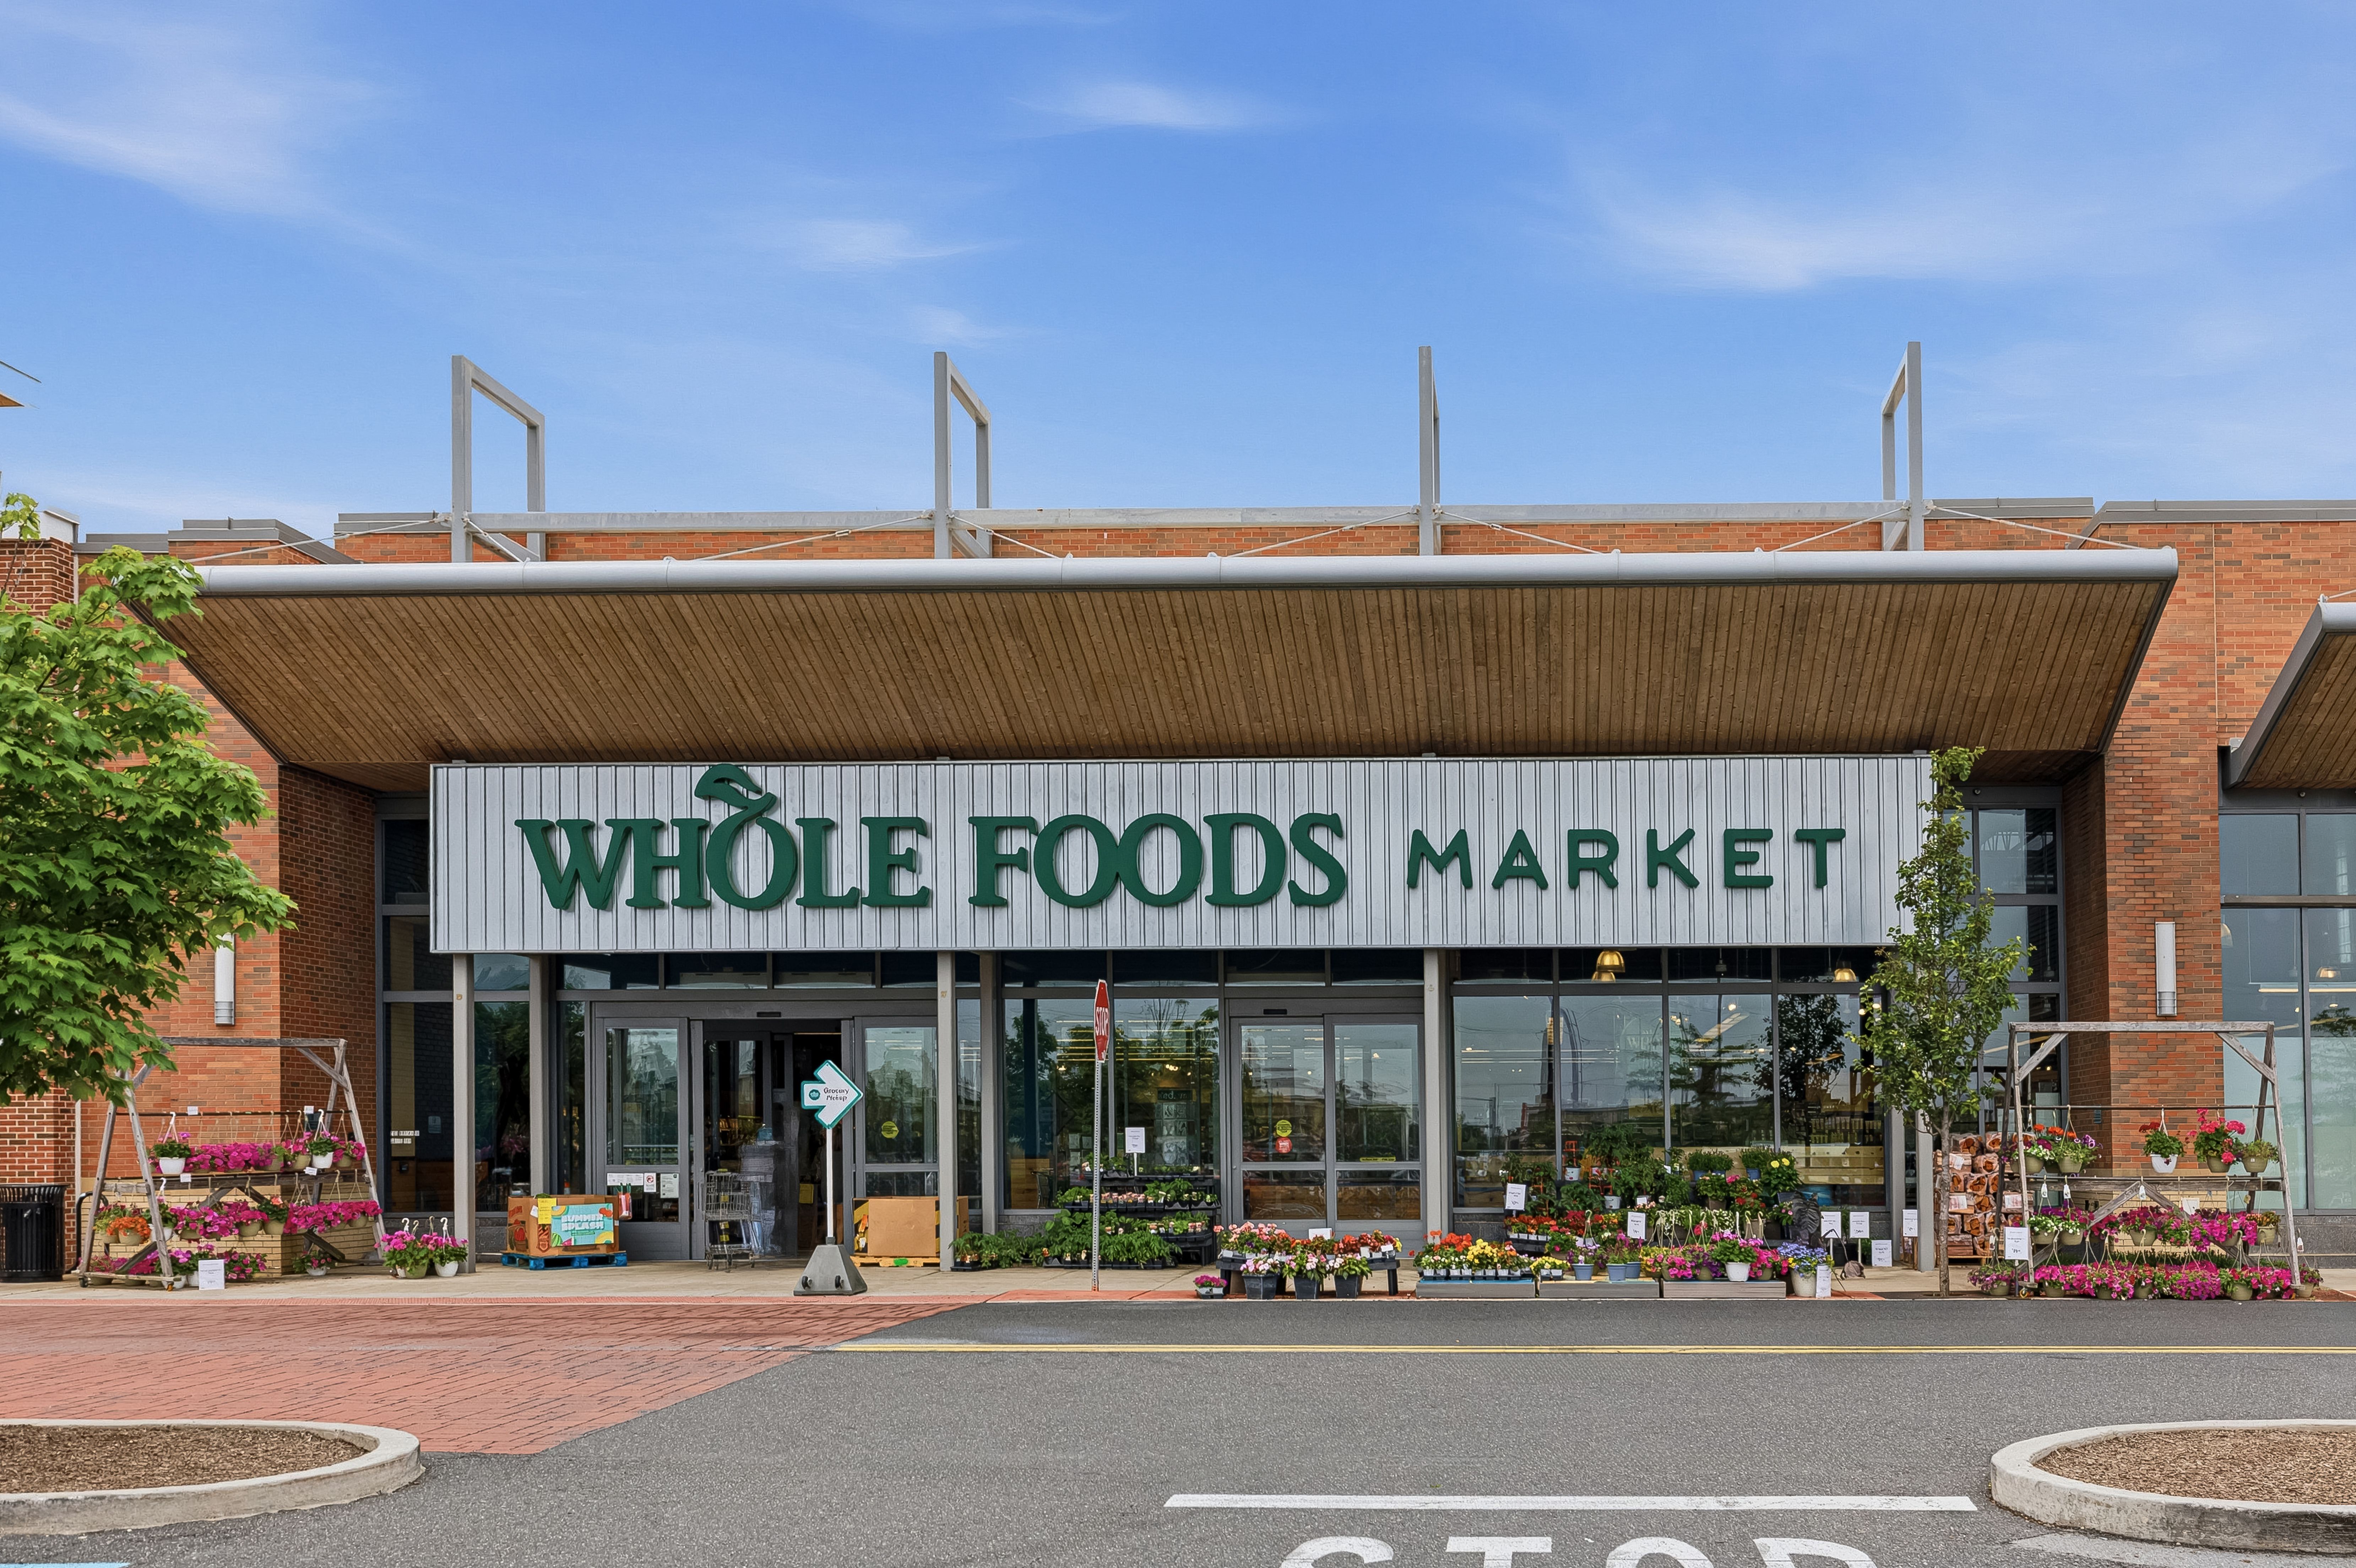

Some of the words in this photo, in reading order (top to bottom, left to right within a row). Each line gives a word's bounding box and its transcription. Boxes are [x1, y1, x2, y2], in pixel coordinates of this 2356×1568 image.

[515, 764, 930, 910] WHOLE
[968, 813, 1347, 907] FOODS
[1407, 829, 1846, 888] MARKET
[1095, 1007, 1108, 1036] STOP
